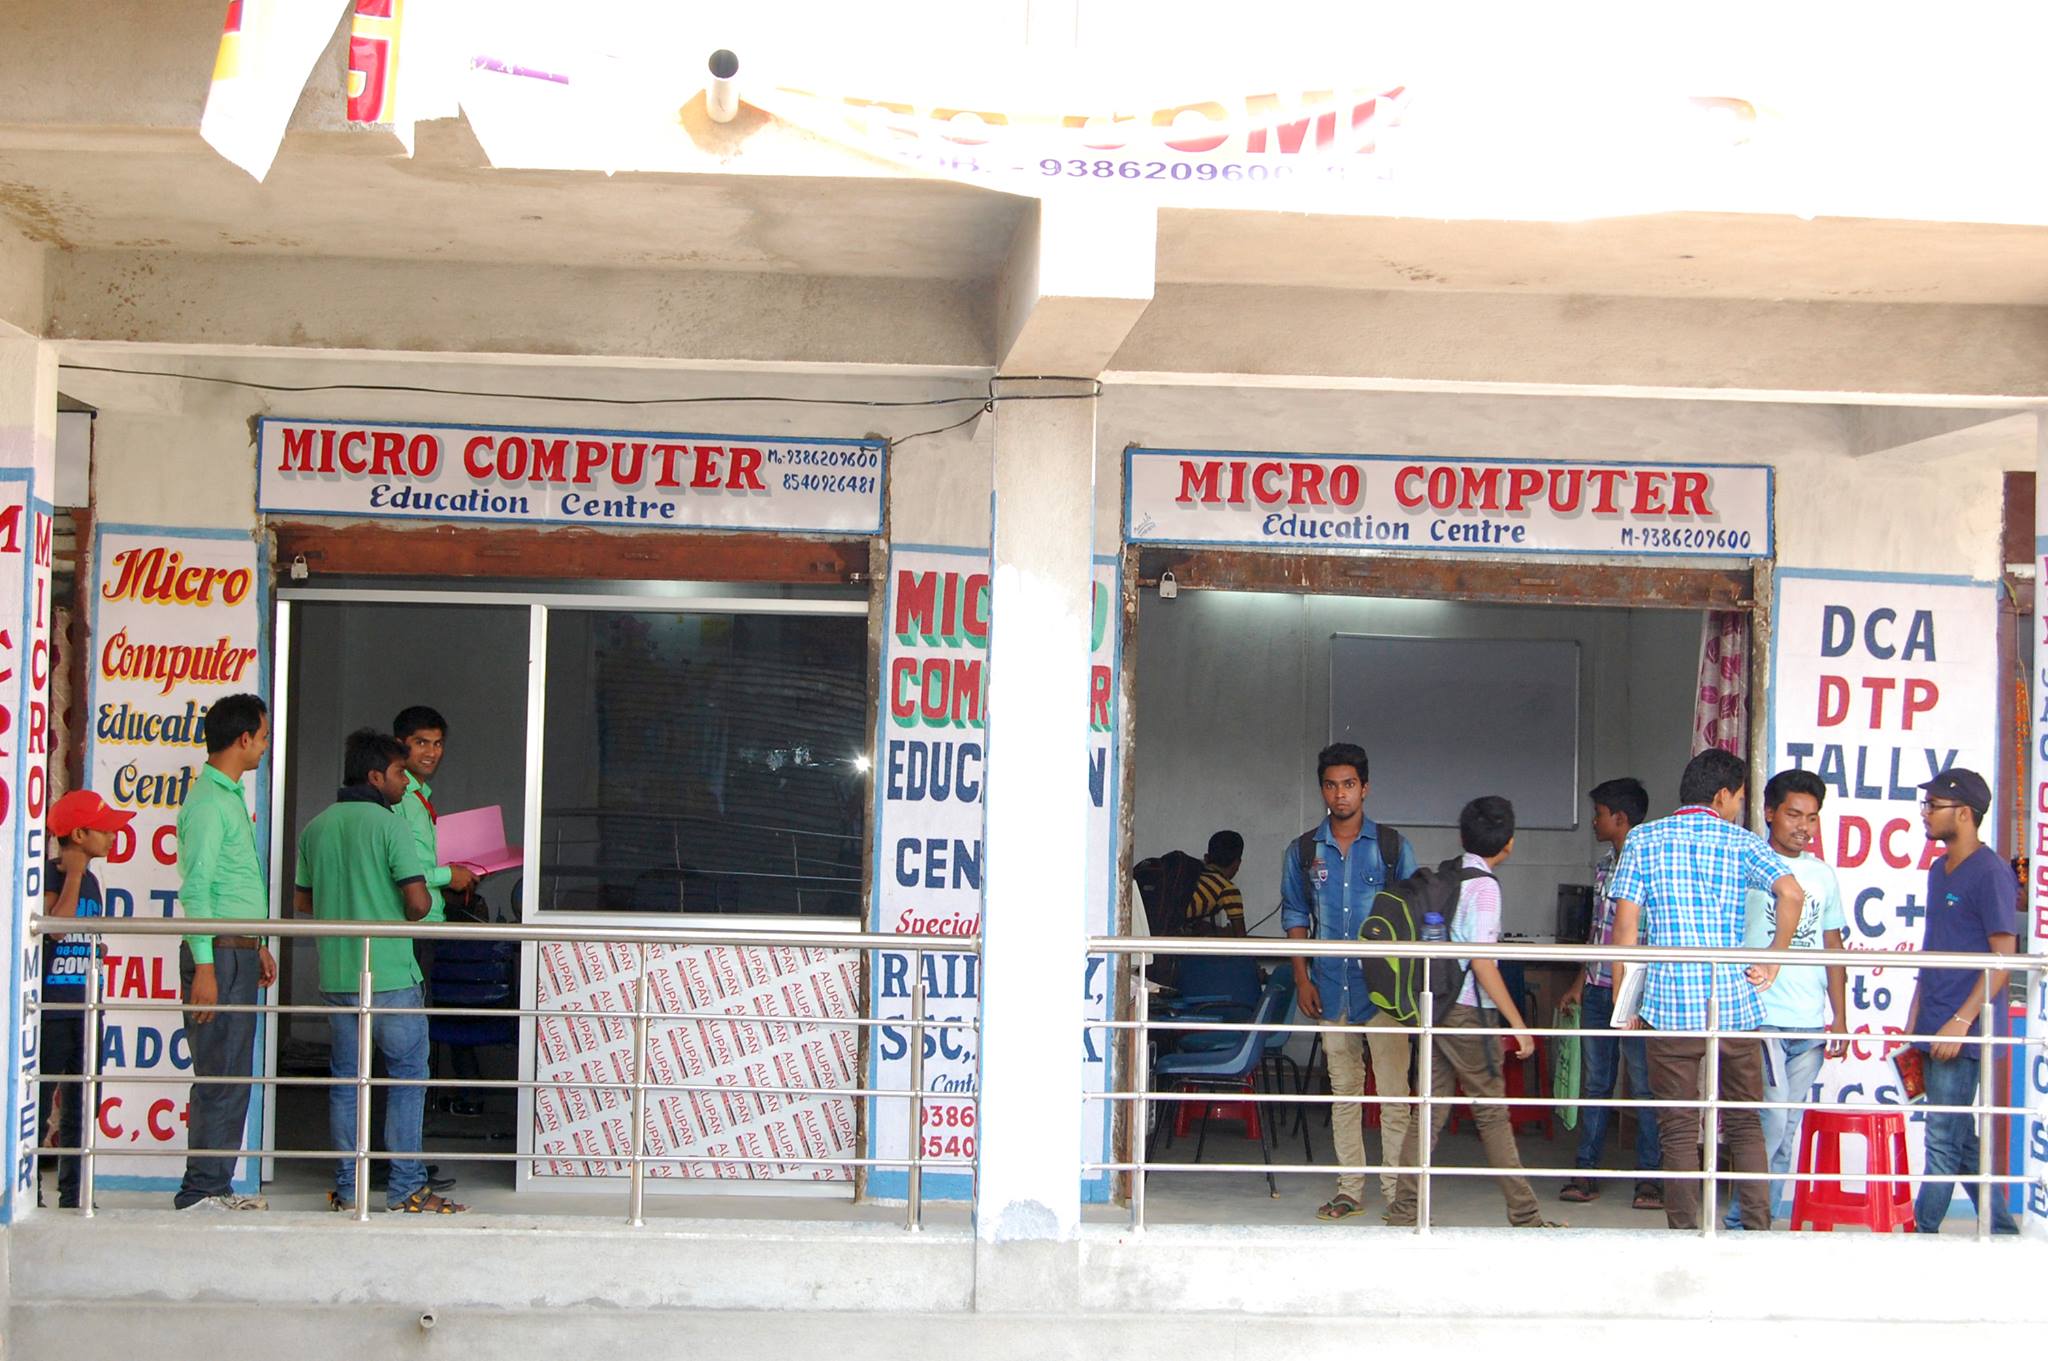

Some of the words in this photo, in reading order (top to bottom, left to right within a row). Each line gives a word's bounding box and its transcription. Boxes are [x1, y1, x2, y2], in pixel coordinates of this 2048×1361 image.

[279, 427, 440, 478] MICRO
[464, 434, 766, 490] COMPUTER
[783, 473, 875, 494] 8540926481
[370, 485, 529, 515] Education
[561, 493, 677, 520] Centre
[1175, 460, 1360, 507] MICRO
[1393, 466, 1714, 516] COMPUTER
[1262, 512, 1410, 543] Education
[1430, 517, 1527, 544] Centre
[1621, 527, 1751, 549] M-9386209600
[102, 547, 251, 605] Micro
[1820, 605, 1937, 662] DCA
[102, 625, 257, 694] Computer
[97, 701, 208, 746] Educati
[1816, 674, 1940, 731] DTP
[113, 758, 196, 806] Cent
[552, 943, 576, 993] ALUPAN
[686, 957, 711, 1007] ALUPAN
[715, 945, 740, 996] ALUPAN
[1852, 975, 1892, 1011] to
[102, 1026, 193, 1069] ADC
[678, 1027, 702, 1076] ALUPAN
[670, 1095, 694, 1145] ALUPAN
[832, 1099, 856, 1149] ALUPAN
